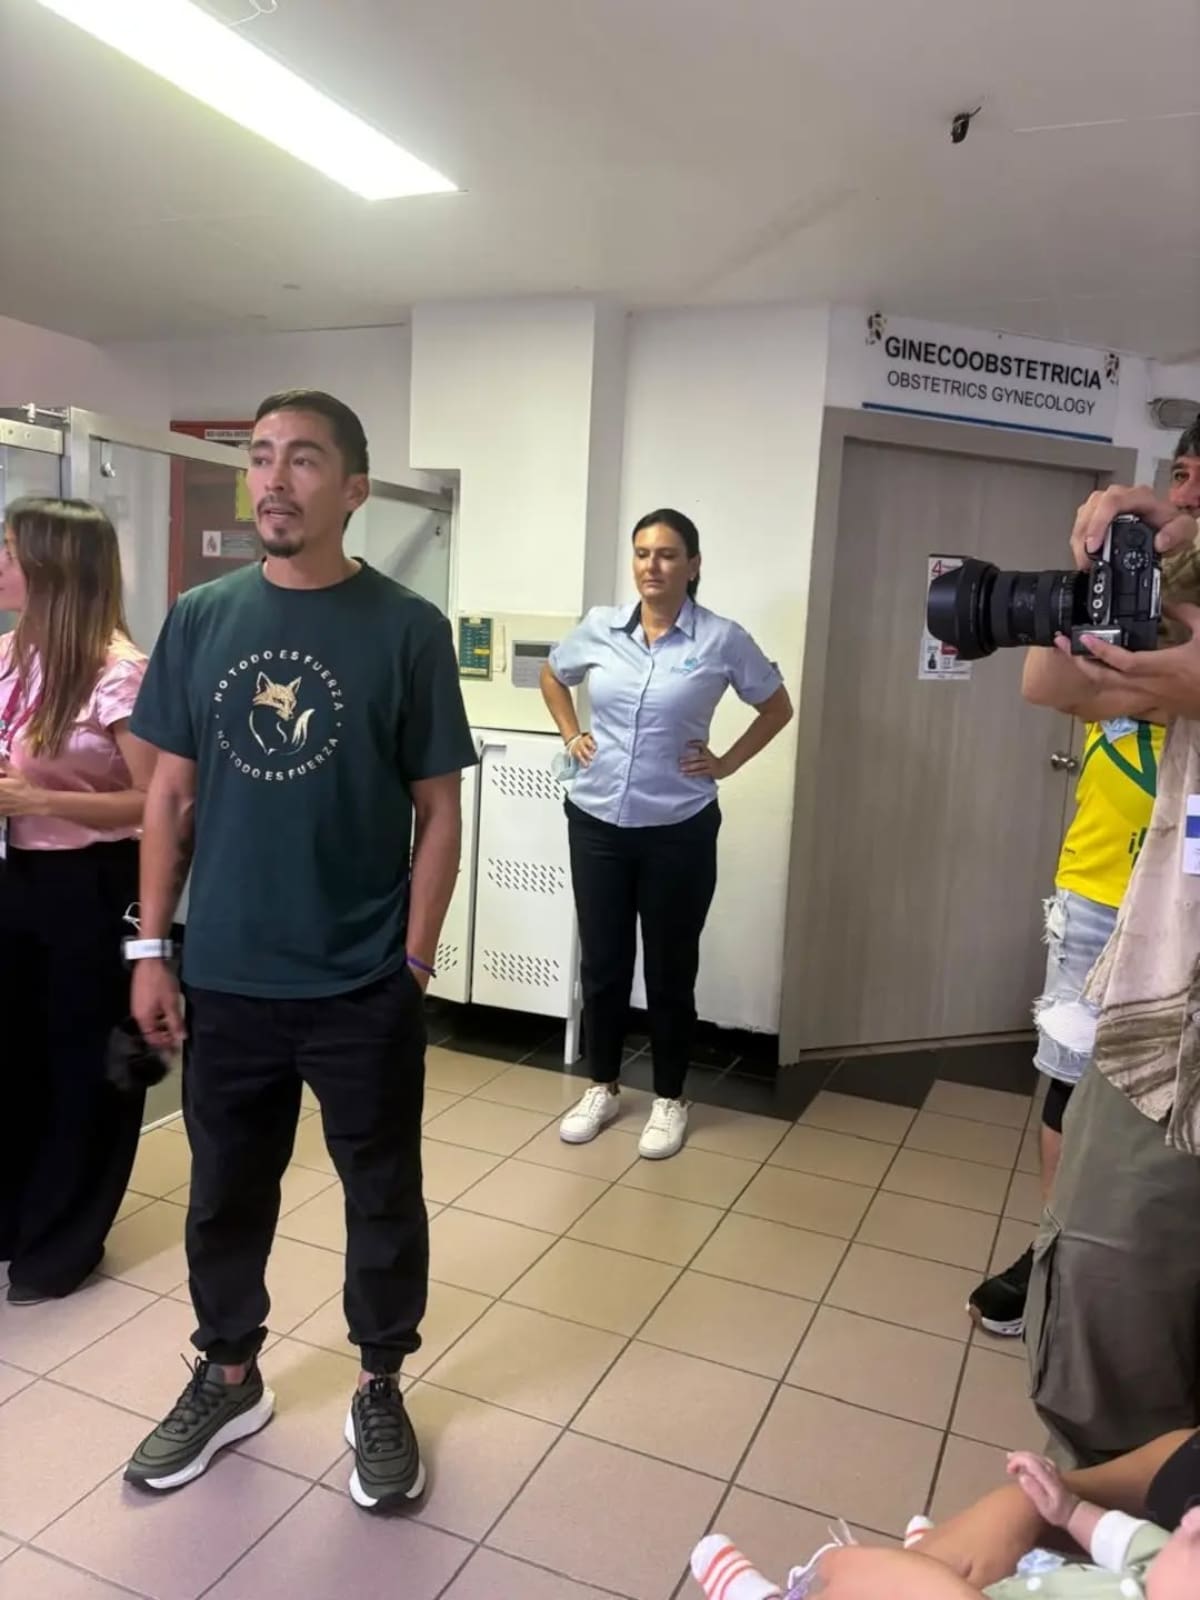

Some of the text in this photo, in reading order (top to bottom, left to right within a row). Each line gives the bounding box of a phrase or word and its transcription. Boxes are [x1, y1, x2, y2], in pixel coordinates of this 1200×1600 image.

[885, 336, 1101, 390] GINECOOBSTETRICIA
[887, 370, 1096, 416] OBSTETRICS GYNECOLOGY
[213, 649, 344, 711] NO TODO ES FUERZA
[229, 750, 261, 779] TODO
[265, 770, 284, 781] ES
[288, 737, 339, 780] FUERZA
